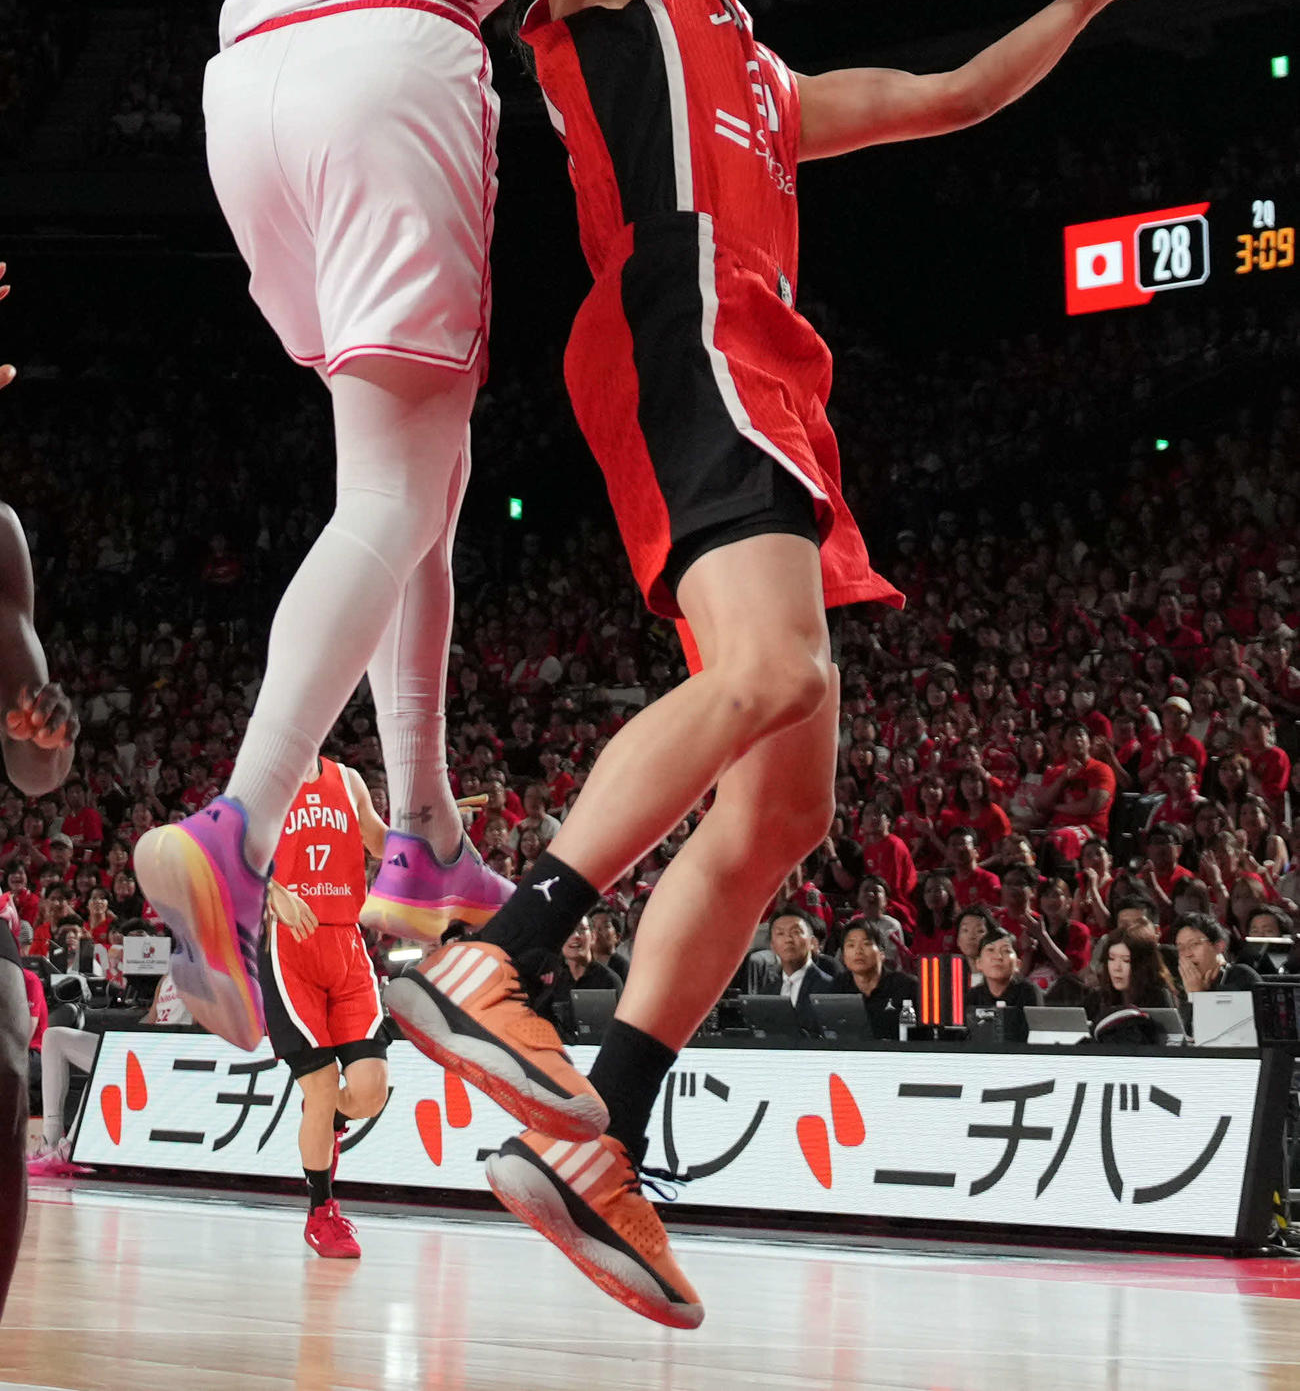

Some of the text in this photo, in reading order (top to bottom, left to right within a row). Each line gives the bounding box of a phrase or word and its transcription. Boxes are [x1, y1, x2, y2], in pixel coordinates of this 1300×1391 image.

[1152, 224, 1192, 282] 28
[1235, 227, 1295, 274] 3:09
[285, 806, 348, 835] JAPAN
[305, 844, 331, 871] 17
[300, 882, 352, 897] SoftBank
[873, 1078, 1232, 1205] ニチバン
